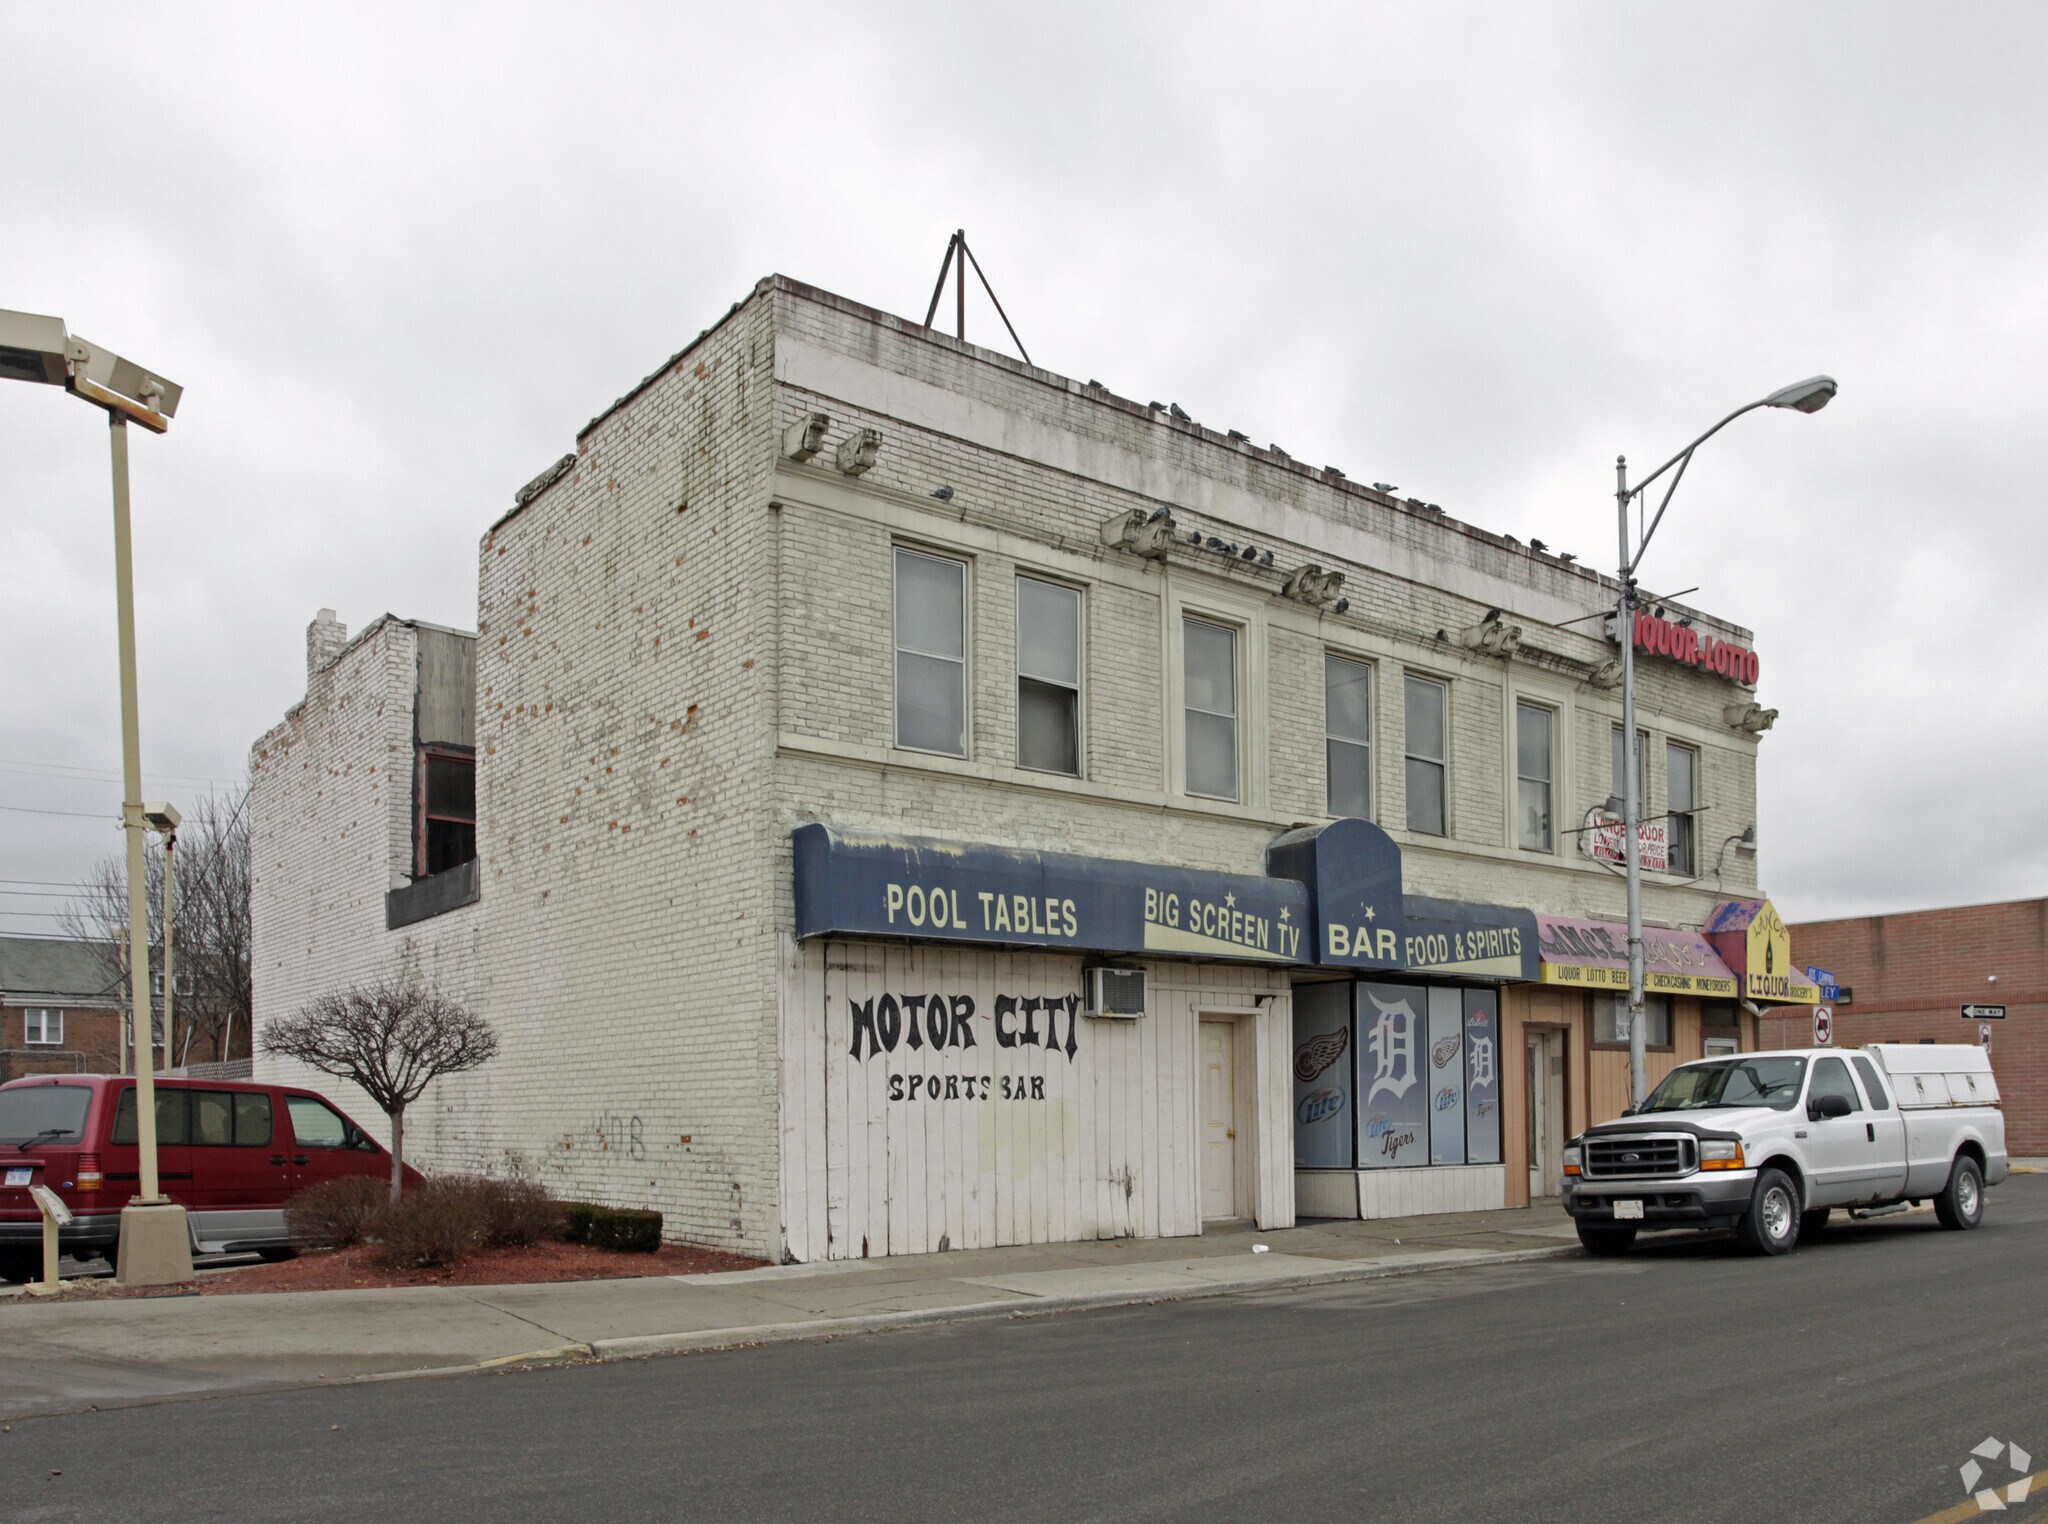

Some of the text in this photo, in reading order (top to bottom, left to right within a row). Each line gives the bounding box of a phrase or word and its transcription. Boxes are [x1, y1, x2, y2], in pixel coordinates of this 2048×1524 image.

[887, 884, 1078, 937] POOL TABLES
[1144, 887, 1300, 957] BIG SCREEN TV
[1753, 911, 1787, 941] LANCE
[1328, 923, 1521, 966] BAR FOOD & SPIRITS
[1558, 966, 1580, 981] LIQUOR
[1587, 968, 1606, 983] LOTTO
[1612, 971, 1627, 985] BEER
[1749, 974, 1789, 998] LIQUOR
[849, 992, 1081, 1065] MOTOR CITY
[889, 1073, 991, 1101] SPORTS
[1381, 1127, 1415, 1160] Tigers
